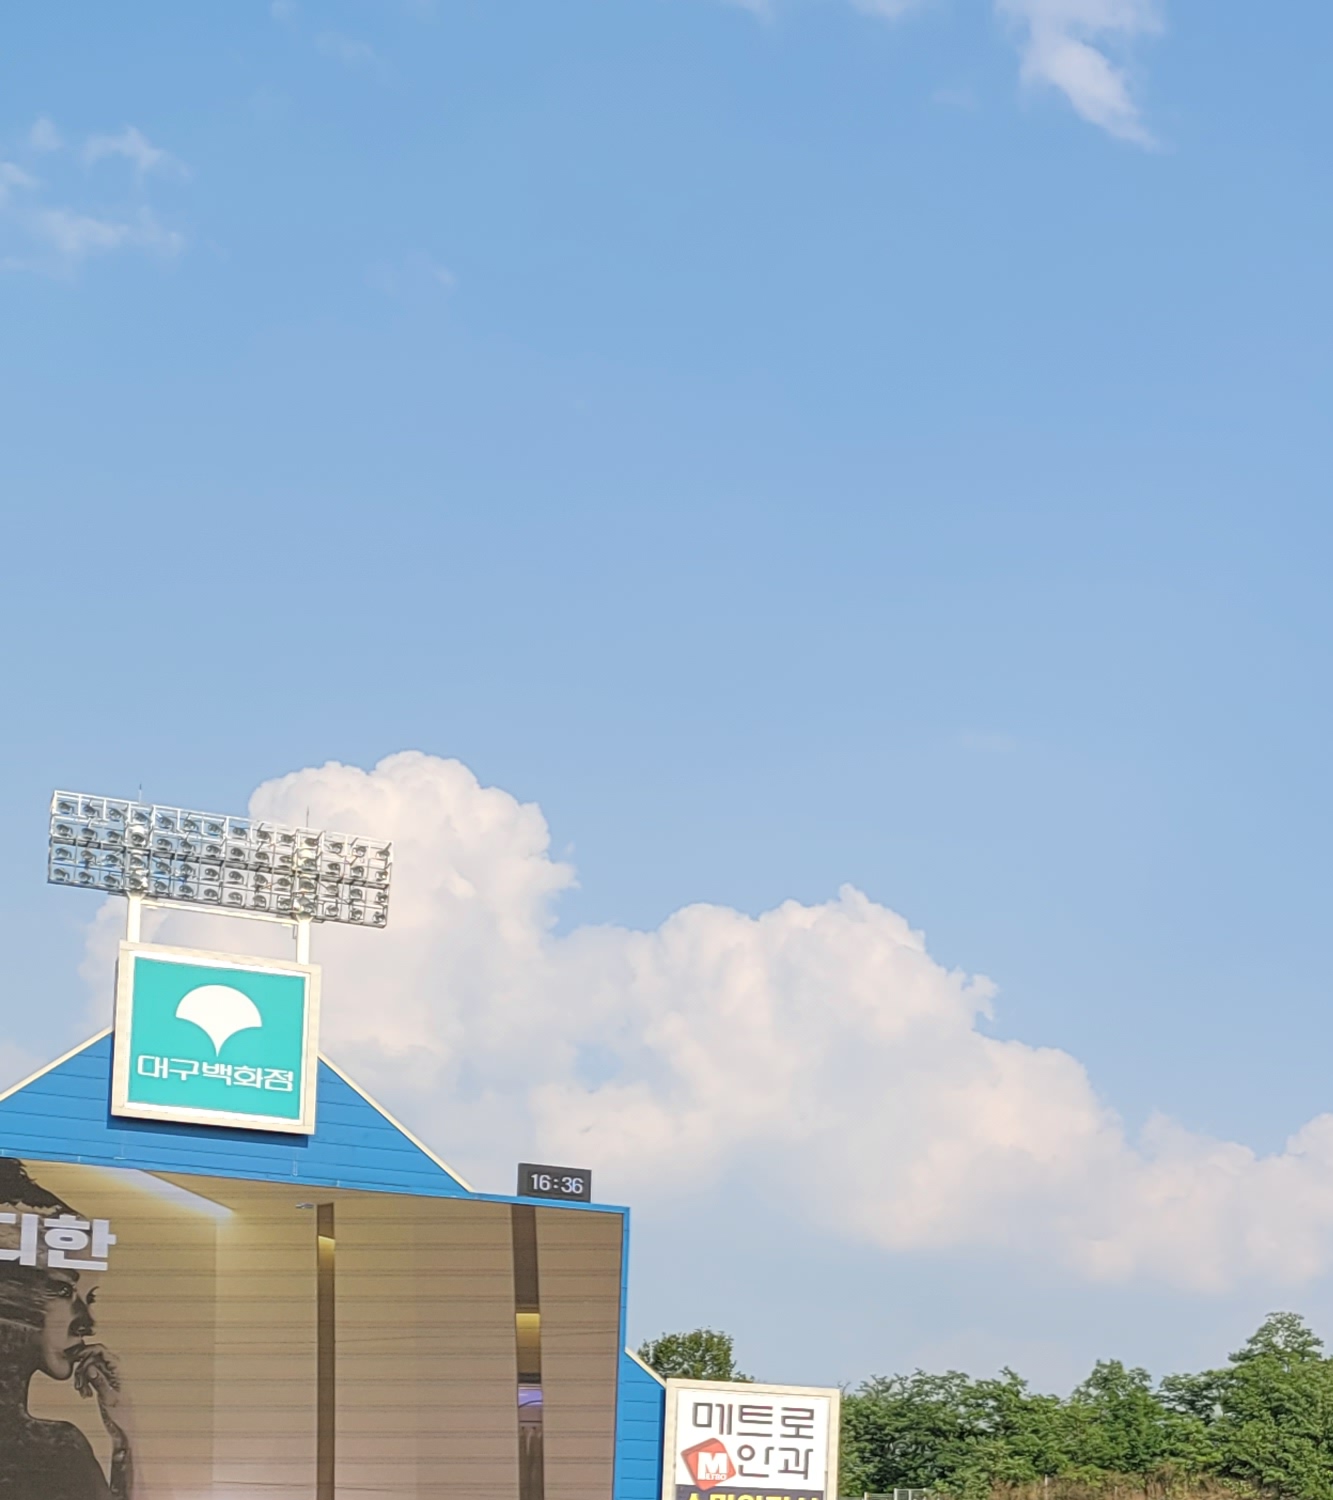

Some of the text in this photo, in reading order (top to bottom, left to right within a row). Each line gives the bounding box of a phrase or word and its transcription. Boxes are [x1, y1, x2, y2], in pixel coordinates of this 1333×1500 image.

[137, 1054, 294, 1092] 대구백화점
[530, 1173, 584, 1194] 16:36
[692, 1402, 815, 1439] 메트로
[737, 1444, 814, 1480] 안과
